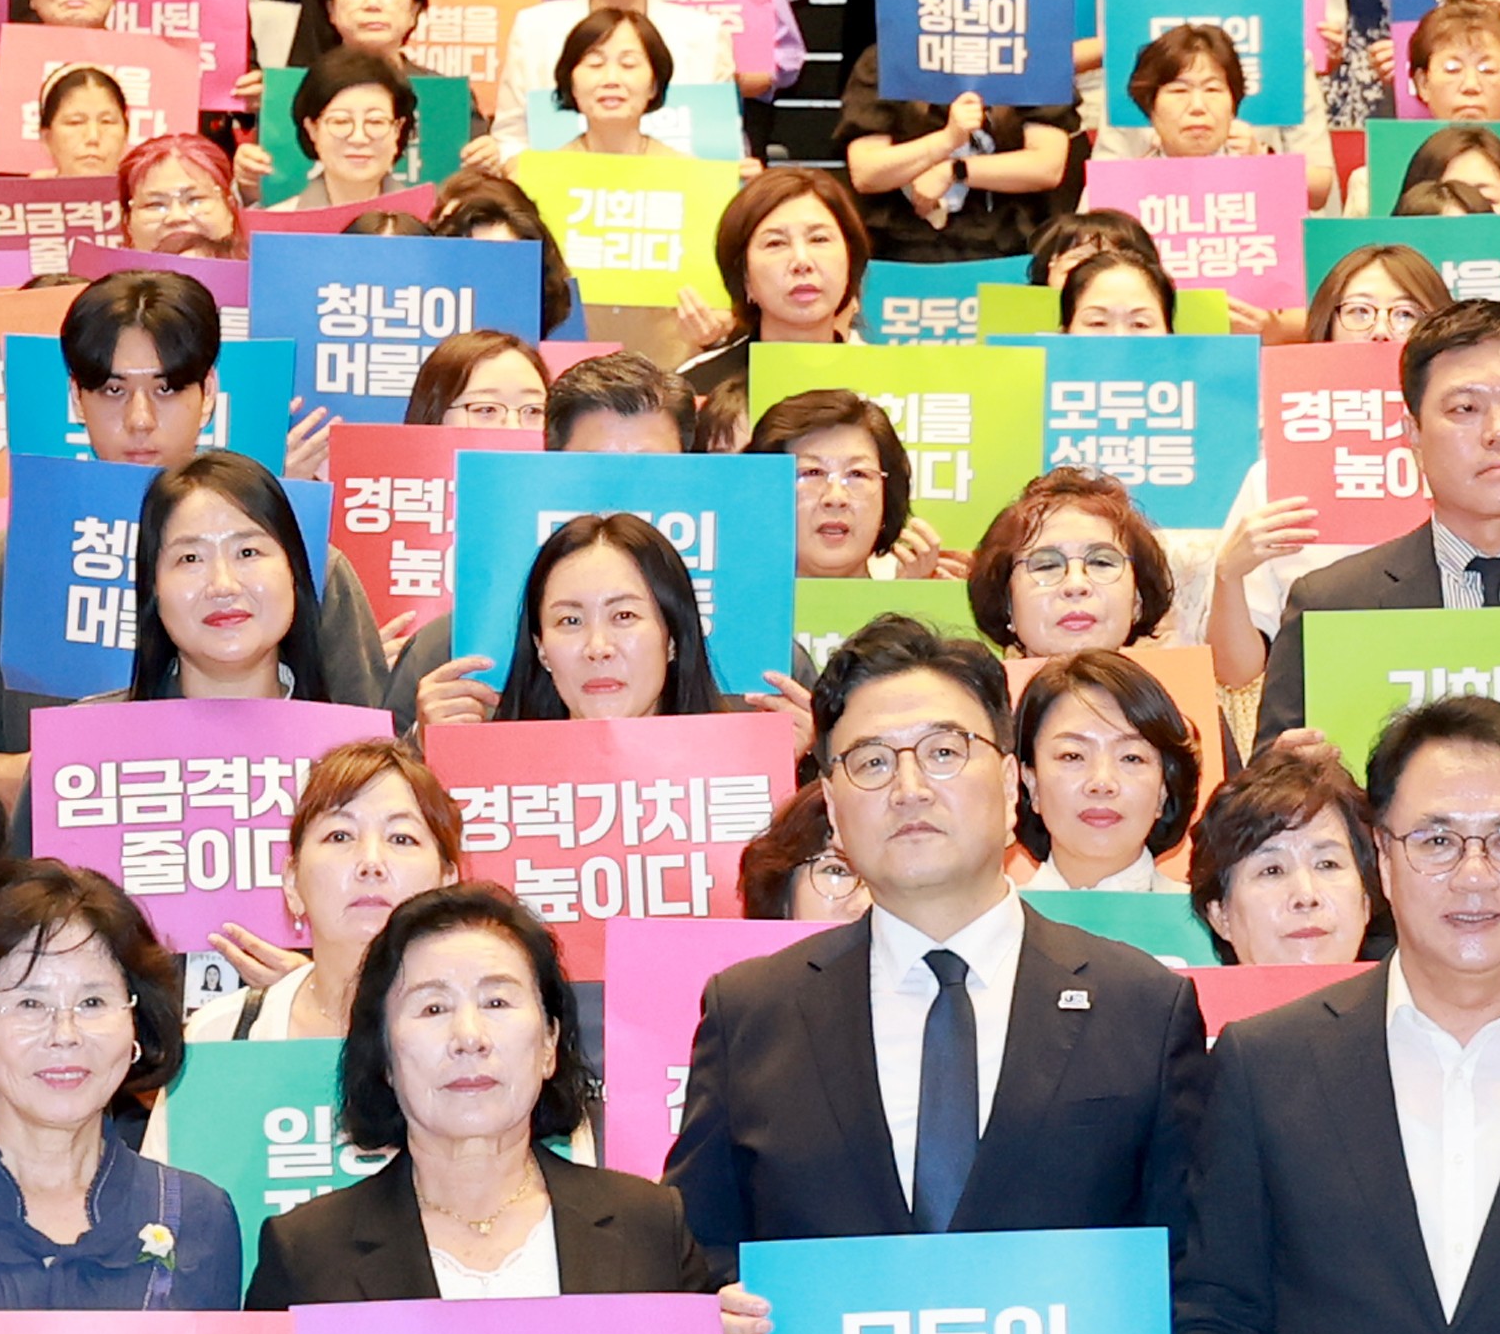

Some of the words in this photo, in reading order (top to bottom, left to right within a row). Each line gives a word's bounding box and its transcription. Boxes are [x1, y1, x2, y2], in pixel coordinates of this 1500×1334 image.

[919, 37, 1028, 75] 머물다
[568, 189, 684, 230] 기회를
[1139, 192, 1257, 234] 하나된
[565, 231, 684, 271] 늘리다
[1170, 235, 1277, 278] 남광주
[318, 283, 472, 338] 청년이
[870, 393, 972, 444] 회를
[1049, 381, 1195, 430] 모두의
[55, 757, 310, 826] 임금격차
[450, 776, 772, 851] 경력가치를
[515, 852, 712, 921] 높이다
